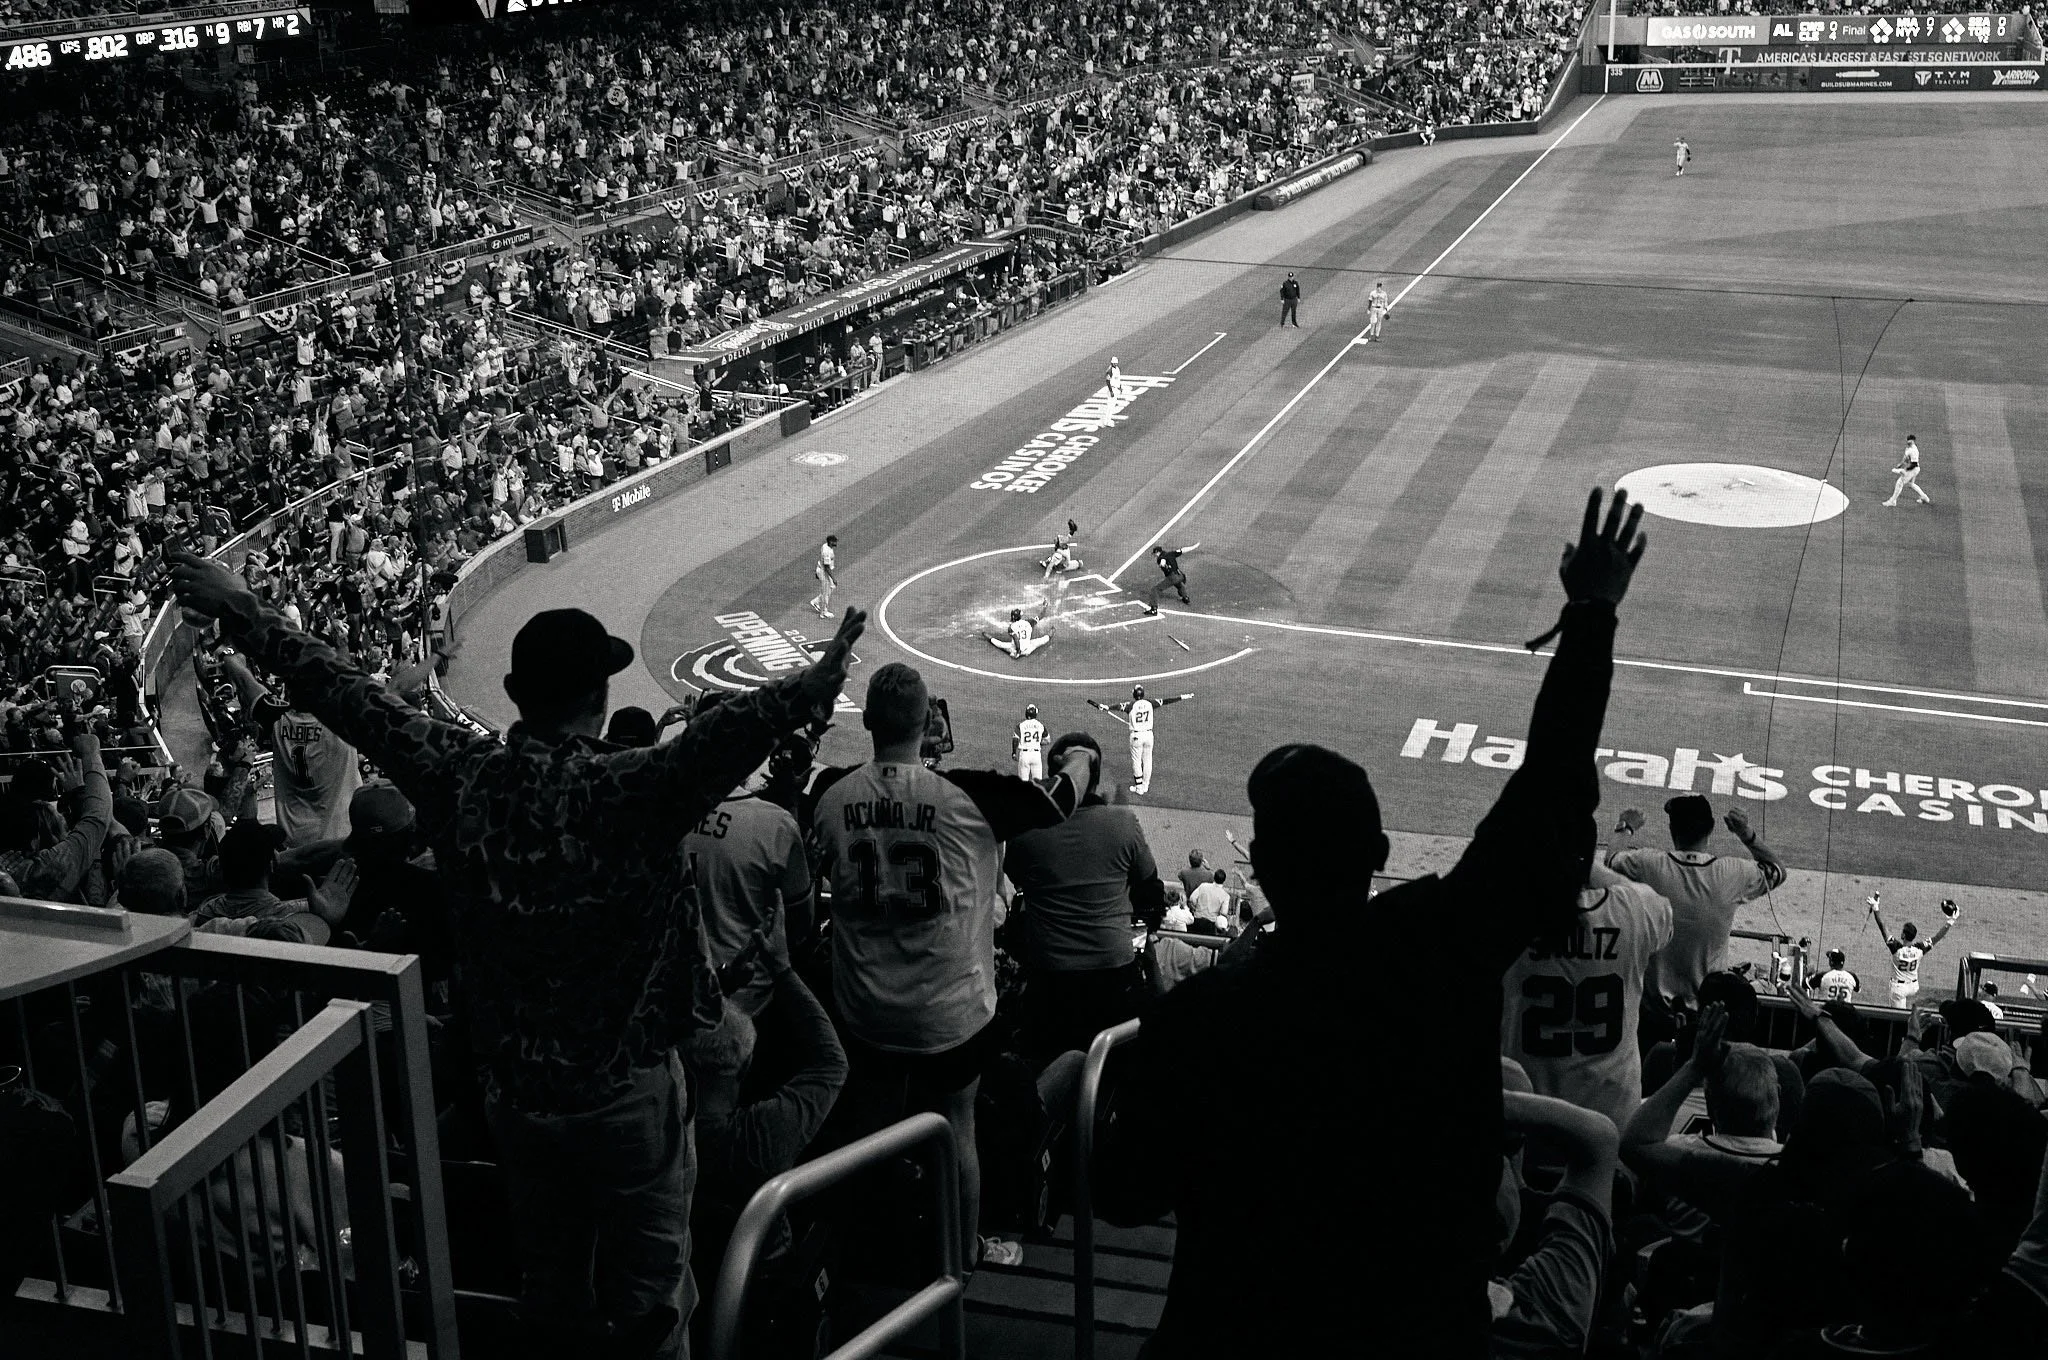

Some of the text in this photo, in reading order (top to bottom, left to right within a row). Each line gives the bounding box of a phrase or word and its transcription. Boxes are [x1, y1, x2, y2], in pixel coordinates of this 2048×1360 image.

[1661, 25, 1756, 39] GAS SOUTH
[1773, 24, 1793, 36] AL
[1842, 25, 1866, 35] Final
[5, 15, 299, 70] .486 OPS .802 OBP .316 H 9 RBI 7 HR 2
[1756, 52, 1816, 62] AMERICA'S
[1819, 52, 1868, 62] LARGEST
[1870, 52, 1878, 62] &
[1928, 51, 1942, 62] 5G
[1944, 51, 2001, 61] NETWORK
[1610, 68, 1623, 76] 335
[502, 232, 531, 247] HYUNDAI
[989, 247, 1005, 258] DELTA
[963, 257, 979, 268] DELTA
[934, 268, 951, 279] DELTA
[904, 279, 921, 291] DELTA
[872, 292, 891, 304] DELTA
[840, 304, 859, 317] DELTA
[804, 318, 825, 332] DELTA
[767, 332, 789, 346] DELTA
[728, 346, 751, 363] DELTA
[970, 433, 1066, 490] CASINOS
[1004, 435, 1100, 493] CHEROKEE
[621, 484, 651, 508] Mobile
[714, 611, 812, 671] OPENING
[1135, 710, 1150, 723] 27
[1024, 731, 1040, 743] 24
[1811, 765, 2048, 811] CHERO
[848, 840, 943, 921] 13
[1898, 960, 1917, 972] 28
[1522, 972, 1624, 1057] 29
